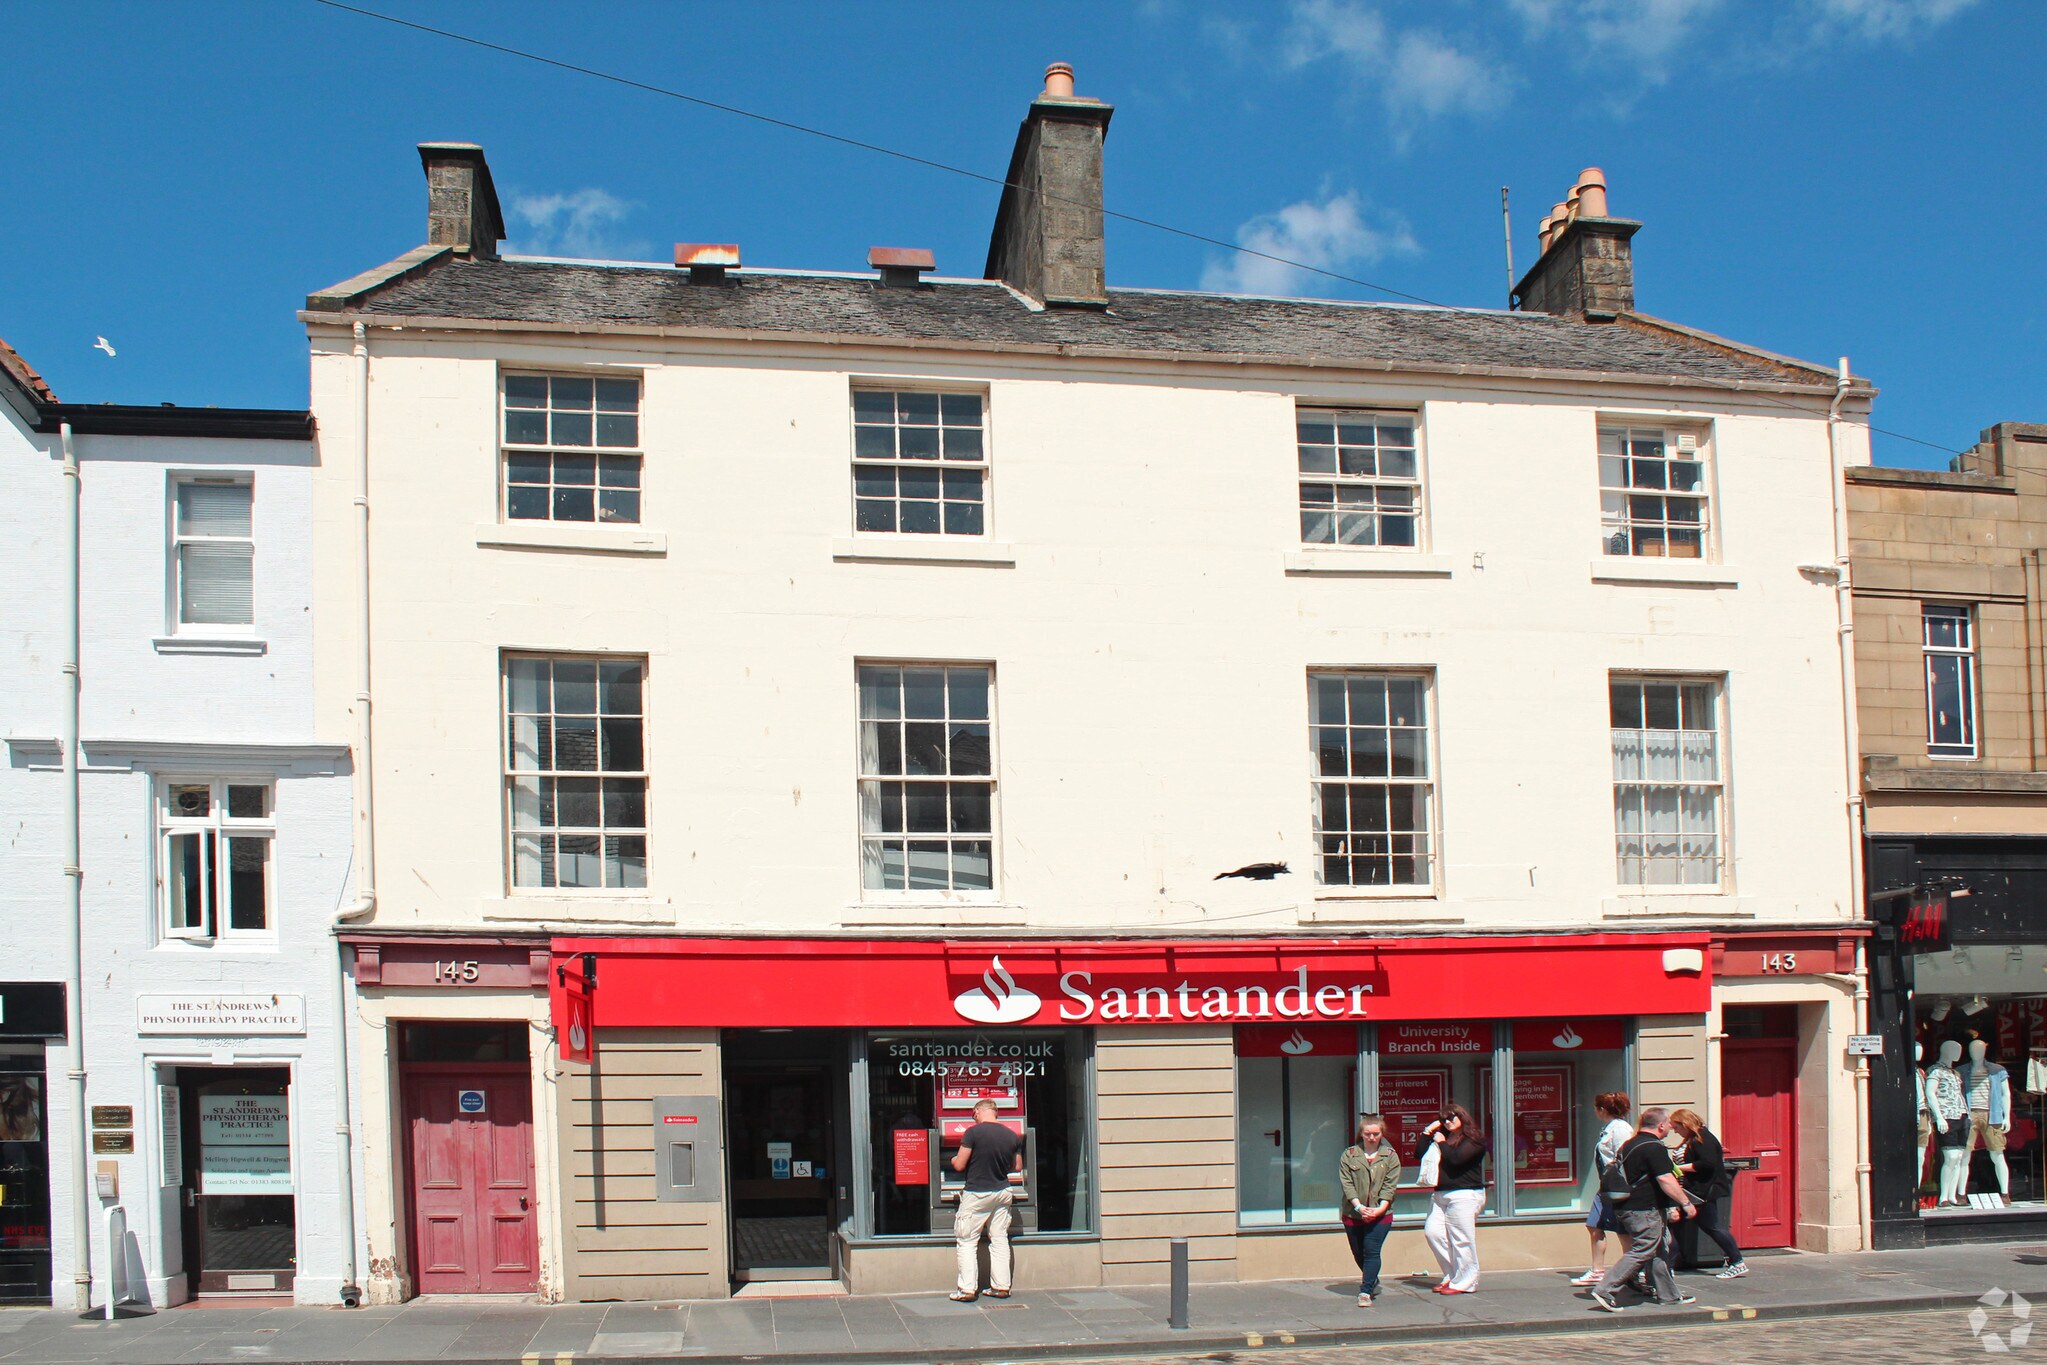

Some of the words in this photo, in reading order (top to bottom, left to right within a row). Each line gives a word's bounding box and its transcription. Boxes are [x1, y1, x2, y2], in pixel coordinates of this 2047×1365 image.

[1901, 902, 1942, 943] H&M
[1761, 953, 1796, 970] 143
[435, 960, 479, 980] 145
[1059, 964, 1373, 1018] Santander
[171, 1002, 194, 1011] THE
[214, 1002, 271, 1011] ANDREWS
[143, 1015, 238, 1024] PHYSIOTHERAPY
[241, 1015, 299, 1024] PRACTICE
[1399, 1026, 1469, 1038] University
[2000, 1002, 2016, 1058] SALE
[889, 1041, 1054, 1057] santander.co.uk
[1388, 1041, 1436, 1053] Branch
[1441, 1040, 1481, 1052] Inside
[899, 1061, 949, 1077] 0845
[954, 1061, 992, 1077] 765
[998, 1061, 1045, 1077] 4321
[1395, 1079, 1428, 1088] interest
[1379, 1090, 1399, 1099] your
[1400, 1097, 1438, 1105] Account.
[220, 1121, 273, 1129] PRACTICE
